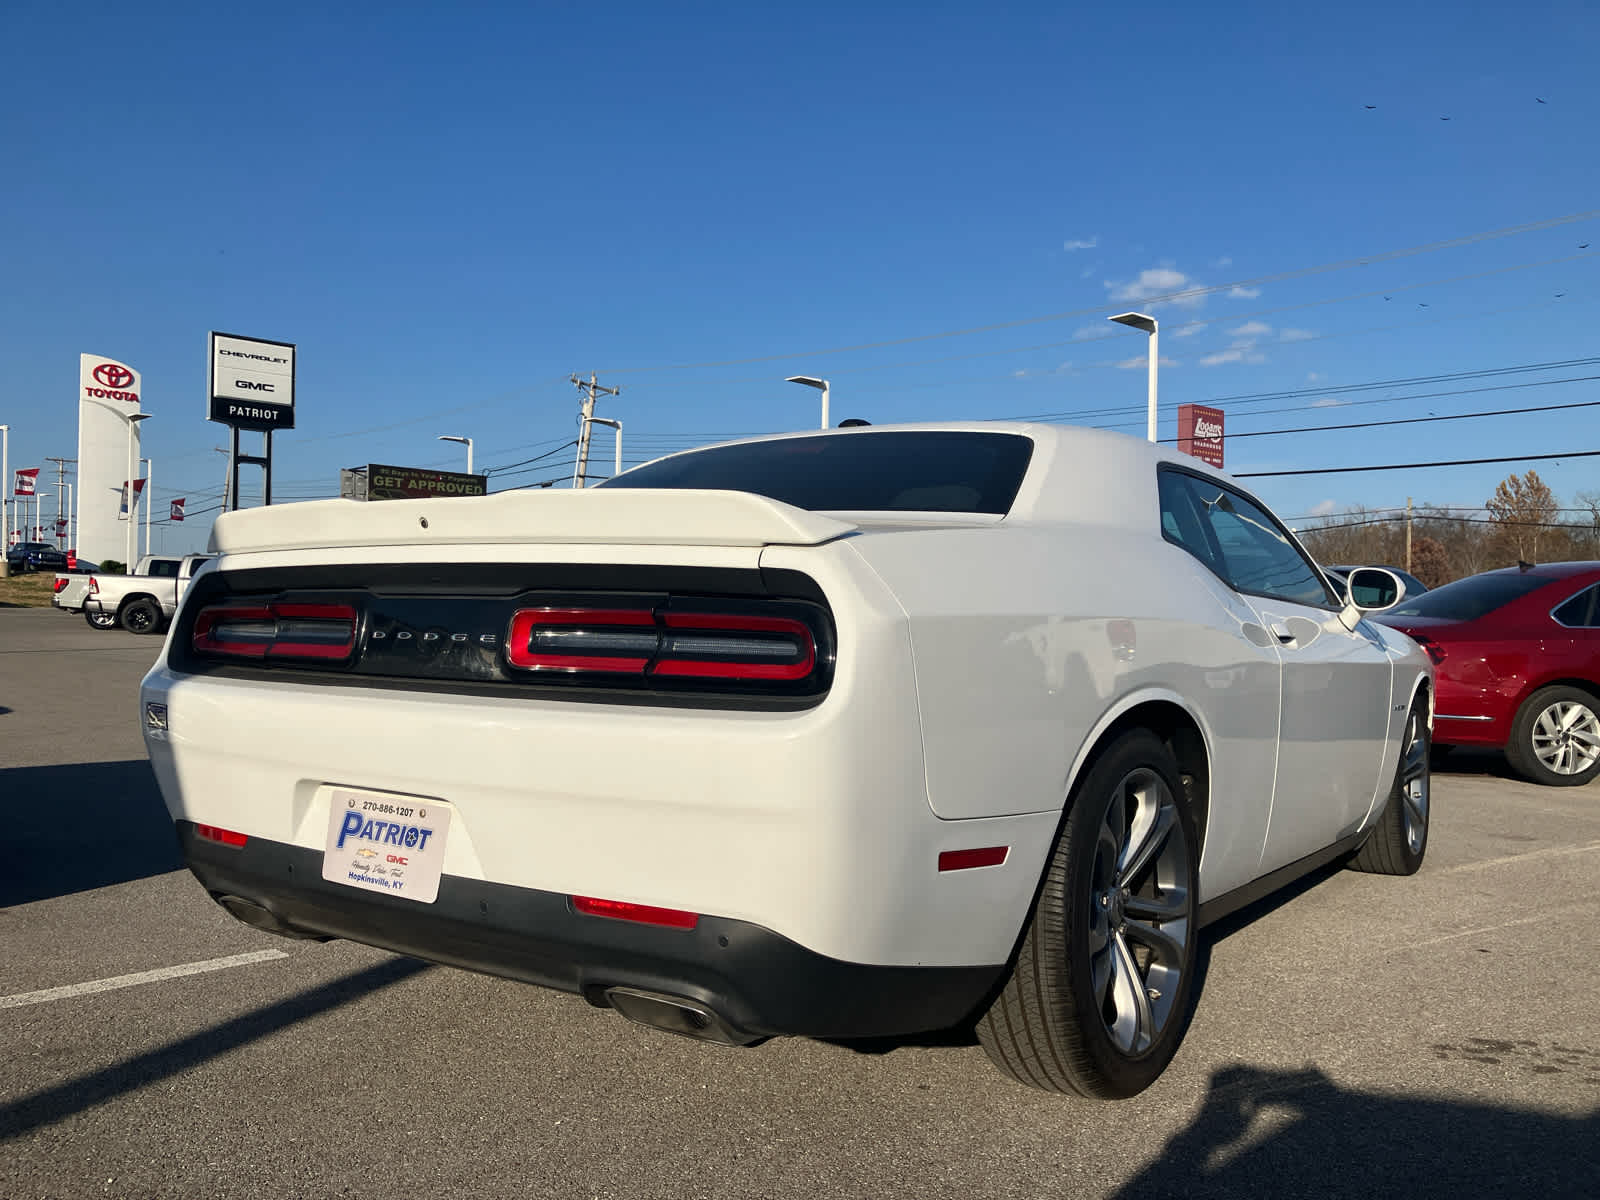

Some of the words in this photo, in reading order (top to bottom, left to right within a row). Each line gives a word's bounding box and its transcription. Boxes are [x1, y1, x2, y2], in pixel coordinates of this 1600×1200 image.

[219, 349, 289, 364] CHEVROLET
[235, 380, 275, 392] GMC
[85, 387, 140, 402] TOYOTA
[229, 405, 279, 420] PATRIOT
[374, 475, 403, 487] GET
[408, 479, 483, 495] APPROVED
[372, 631, 496, 642] DODGE
[363, 801, 414, 817] 270-886-1207
[336, 810, 433, 850] PATRIOT
[386, 854, 408, 866] GMC
[348, 871, 391, 888] Hopkinsville,
[392, 879, 404, 890] KY
